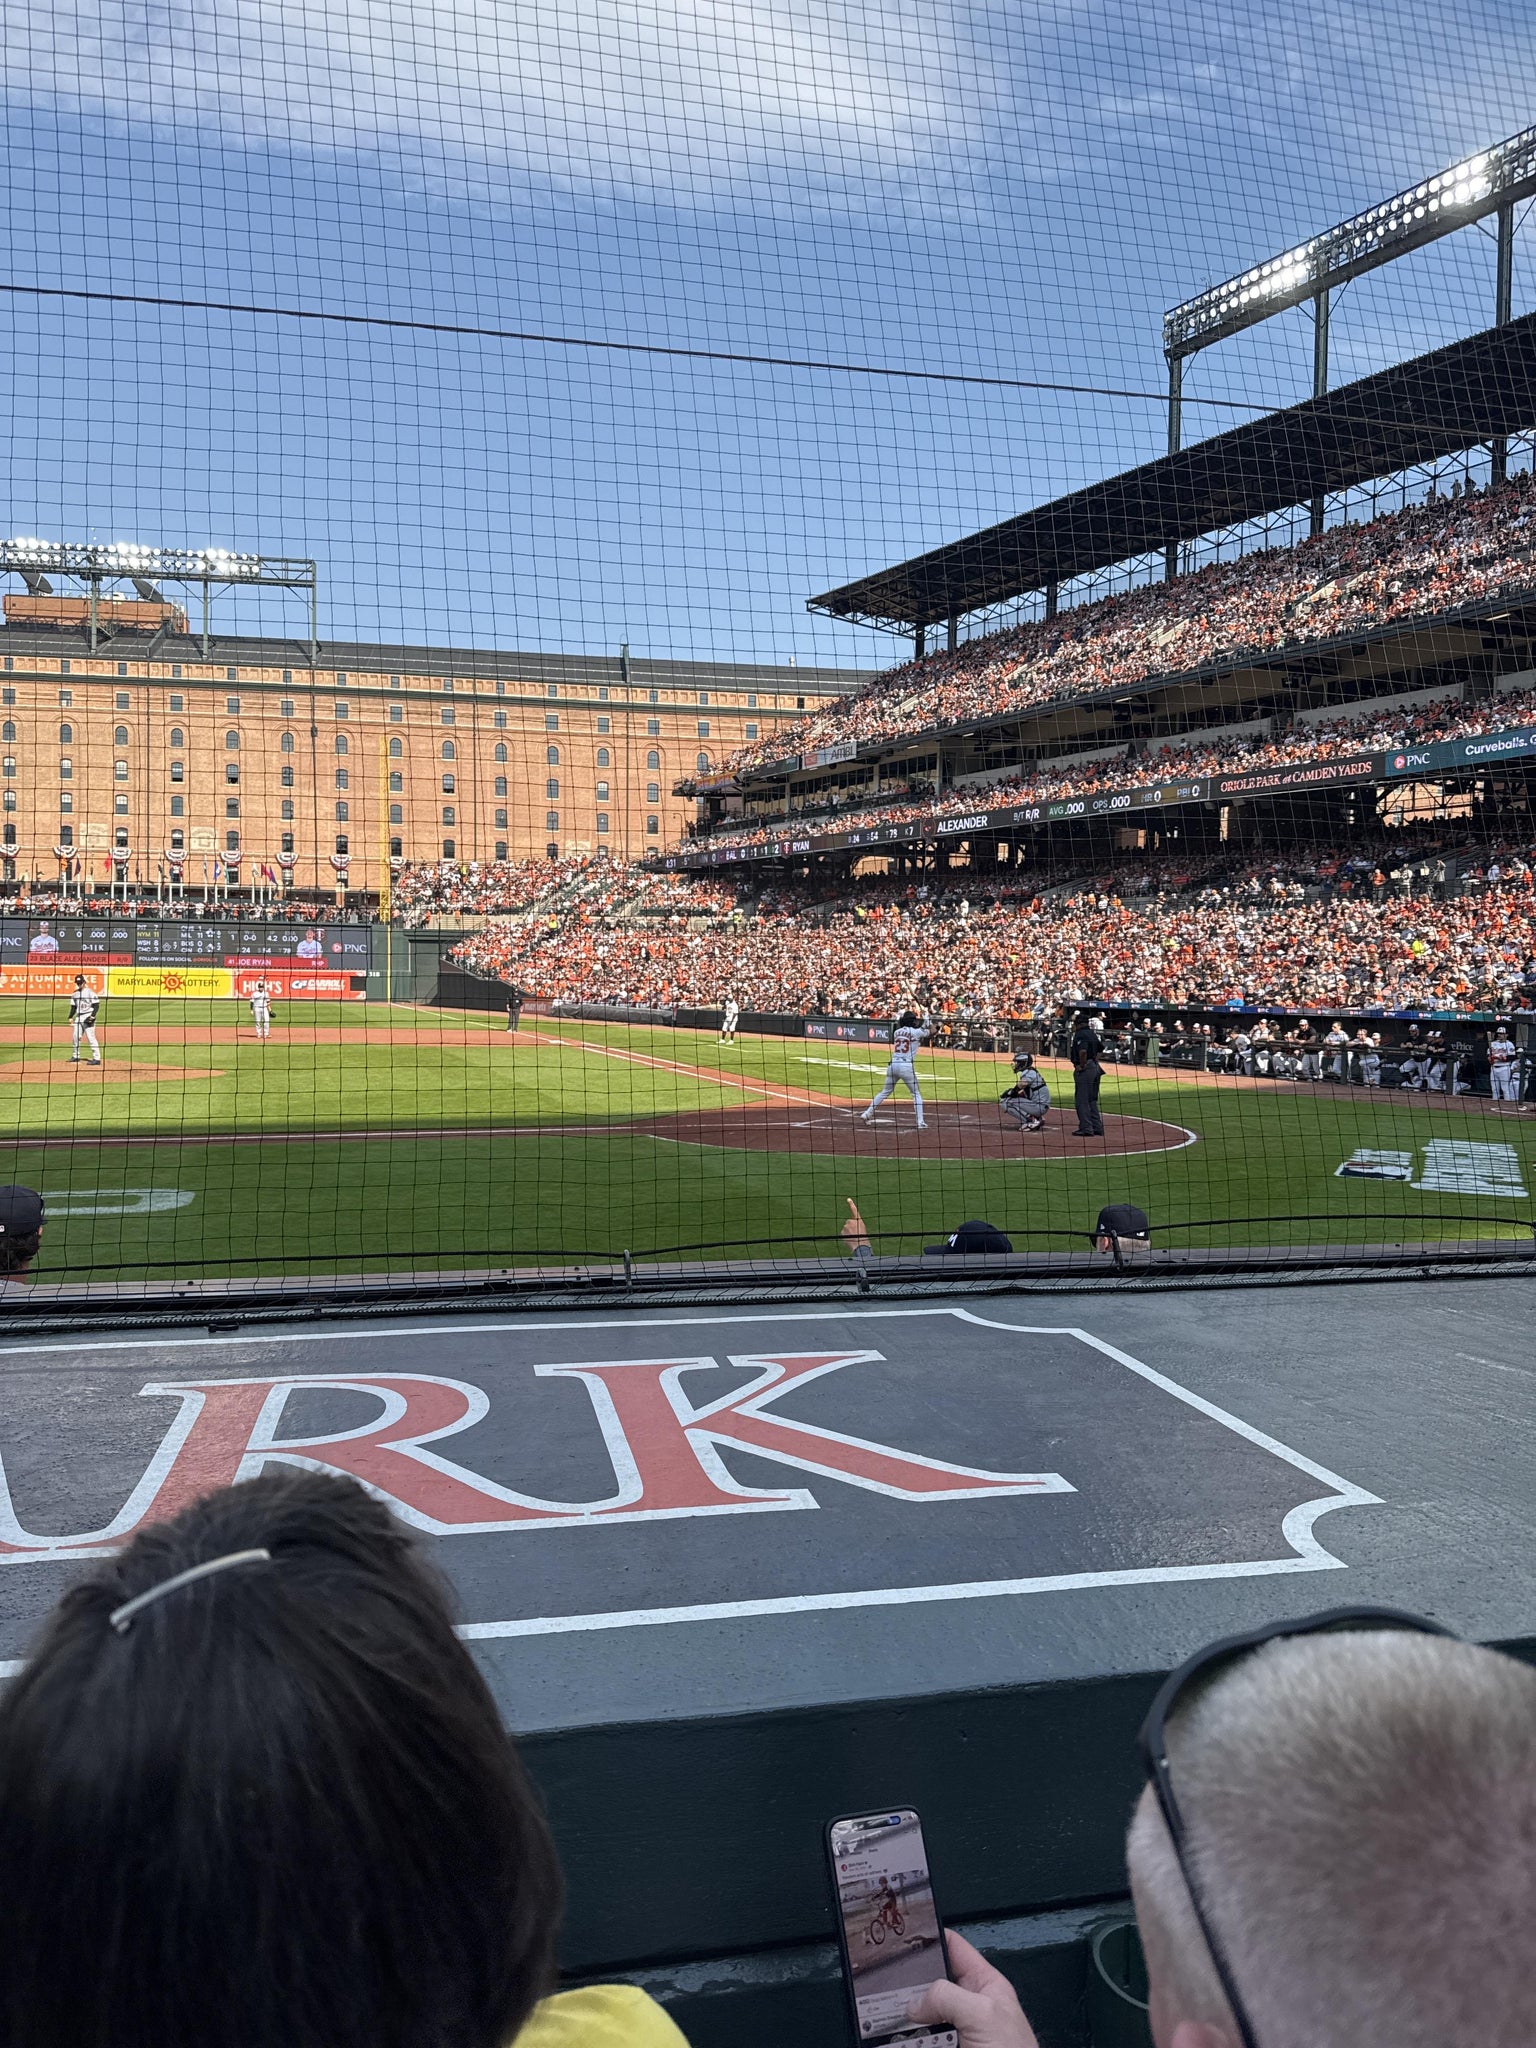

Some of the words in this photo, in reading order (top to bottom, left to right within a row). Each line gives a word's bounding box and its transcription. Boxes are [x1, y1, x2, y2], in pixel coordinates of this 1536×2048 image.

[1406, 752, 1431, 766] PNC
[1220, 777, 1256, 792] ORIOLE
[1256, 774, 1281, 788] PARK
[1292, 766, 1337, 783] CAMDEN
[1337, 761, 1372, 777] YARDS
[1092, 800, 1108, 810] OPS
[1049, 806, 1064, 816] AVG
[937, 815, 988, 833] ALEXANDER
[792, 840, 810, 852] RYAN
[344, 944, 367, 953] PNC
[68, 975, 97, 983] LKE
[812, 1025, 825, 1034] PNC
[843, 1028, 856, 1037] PNC
[875, 1029, 889, 1038] PNC
[894, 1039, 910, 1053] 23
[0, 1350, 1077, 1565] RK
